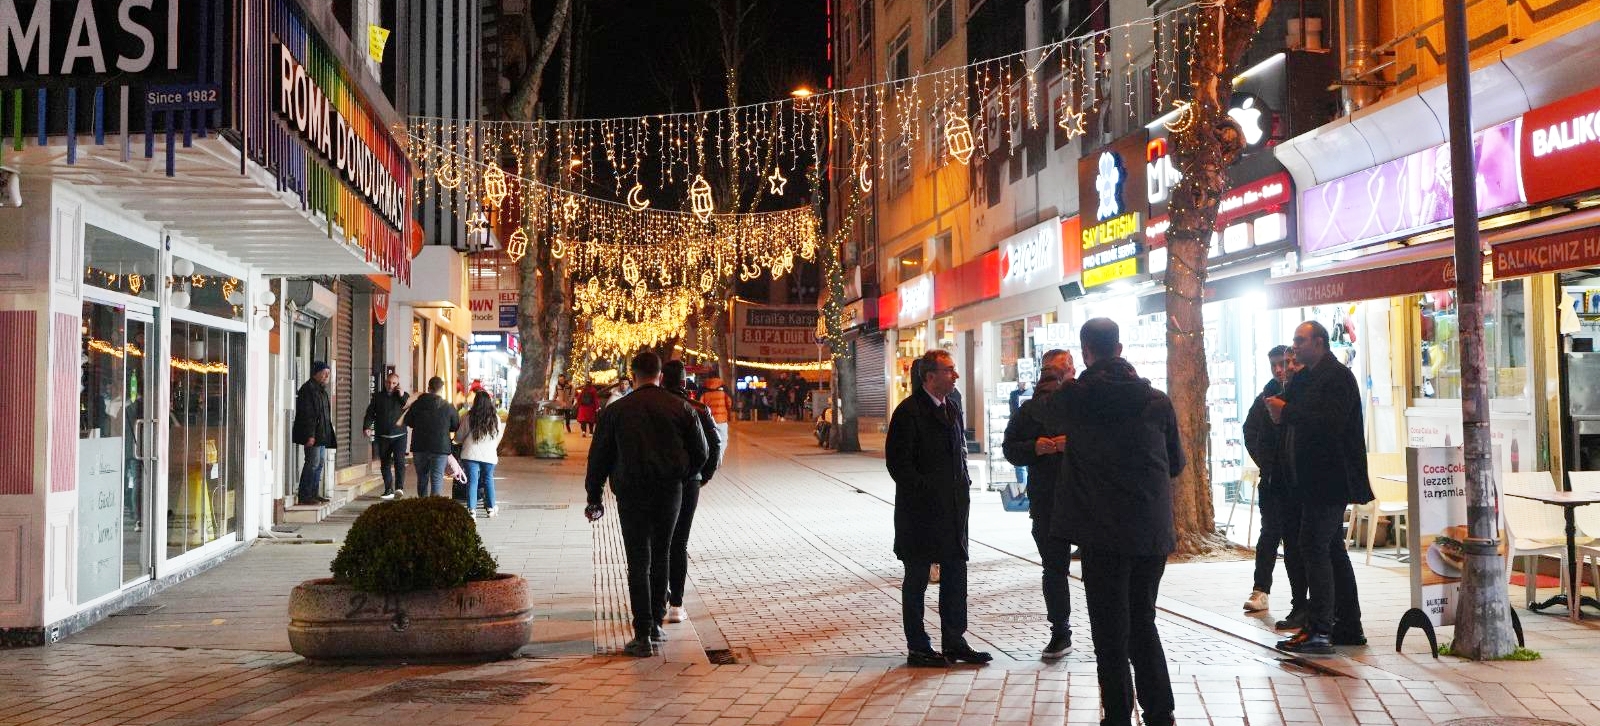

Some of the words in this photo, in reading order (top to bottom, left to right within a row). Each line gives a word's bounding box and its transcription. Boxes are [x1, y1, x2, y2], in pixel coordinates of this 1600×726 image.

[147, 92, 182, 105] Since
[187, 89, 217, 103] 1982
[282, 43, 332, 160] ROMA
[1082, 225, 1099, 250] SAY
[1497, 241, 1580, 271] BALIKÇIMIZ
[1313, 282, 1344, 300] HASAN
[1049, 324, 1066, 340] 30
[1423, 464, 1467, 474] Coca-Cola
[1423, 475, 1454, 487] lezzeti
